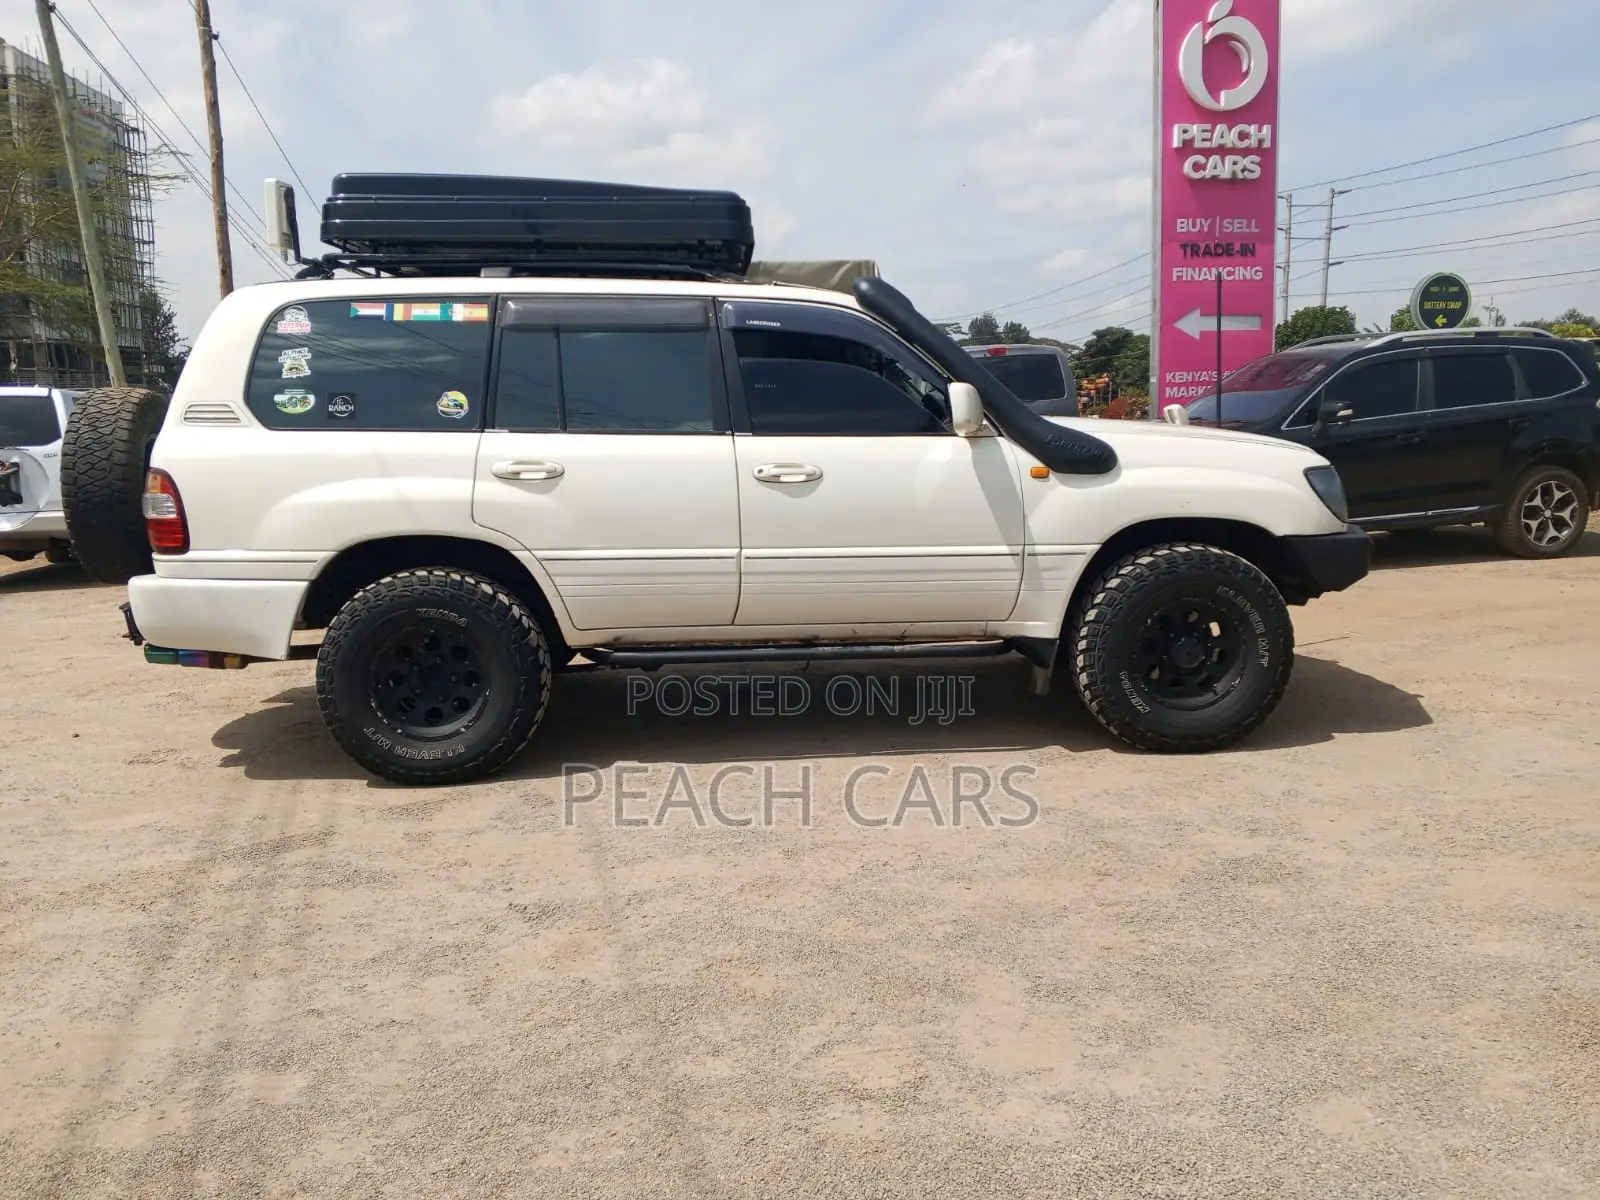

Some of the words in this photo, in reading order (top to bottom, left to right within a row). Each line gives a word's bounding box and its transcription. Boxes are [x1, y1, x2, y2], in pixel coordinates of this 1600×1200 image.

[1173, 124, 1271, 148] PEACH
[1183, 155, 1261, 179] CARS
[1177, 218, 1211, 233] BUY
[1222, 218, 1260, 233] SELL
[1180, 243, 1256, 258] TRADE-IN
[1172, 266, 1263, 281] FINANCING
[328, 404, 354, 412] RANCH
[415, 608, 468, 626] KENDA
[1120, 671, 1151, 714] KENDA
[394, 743, 465, 761] KLEVER
